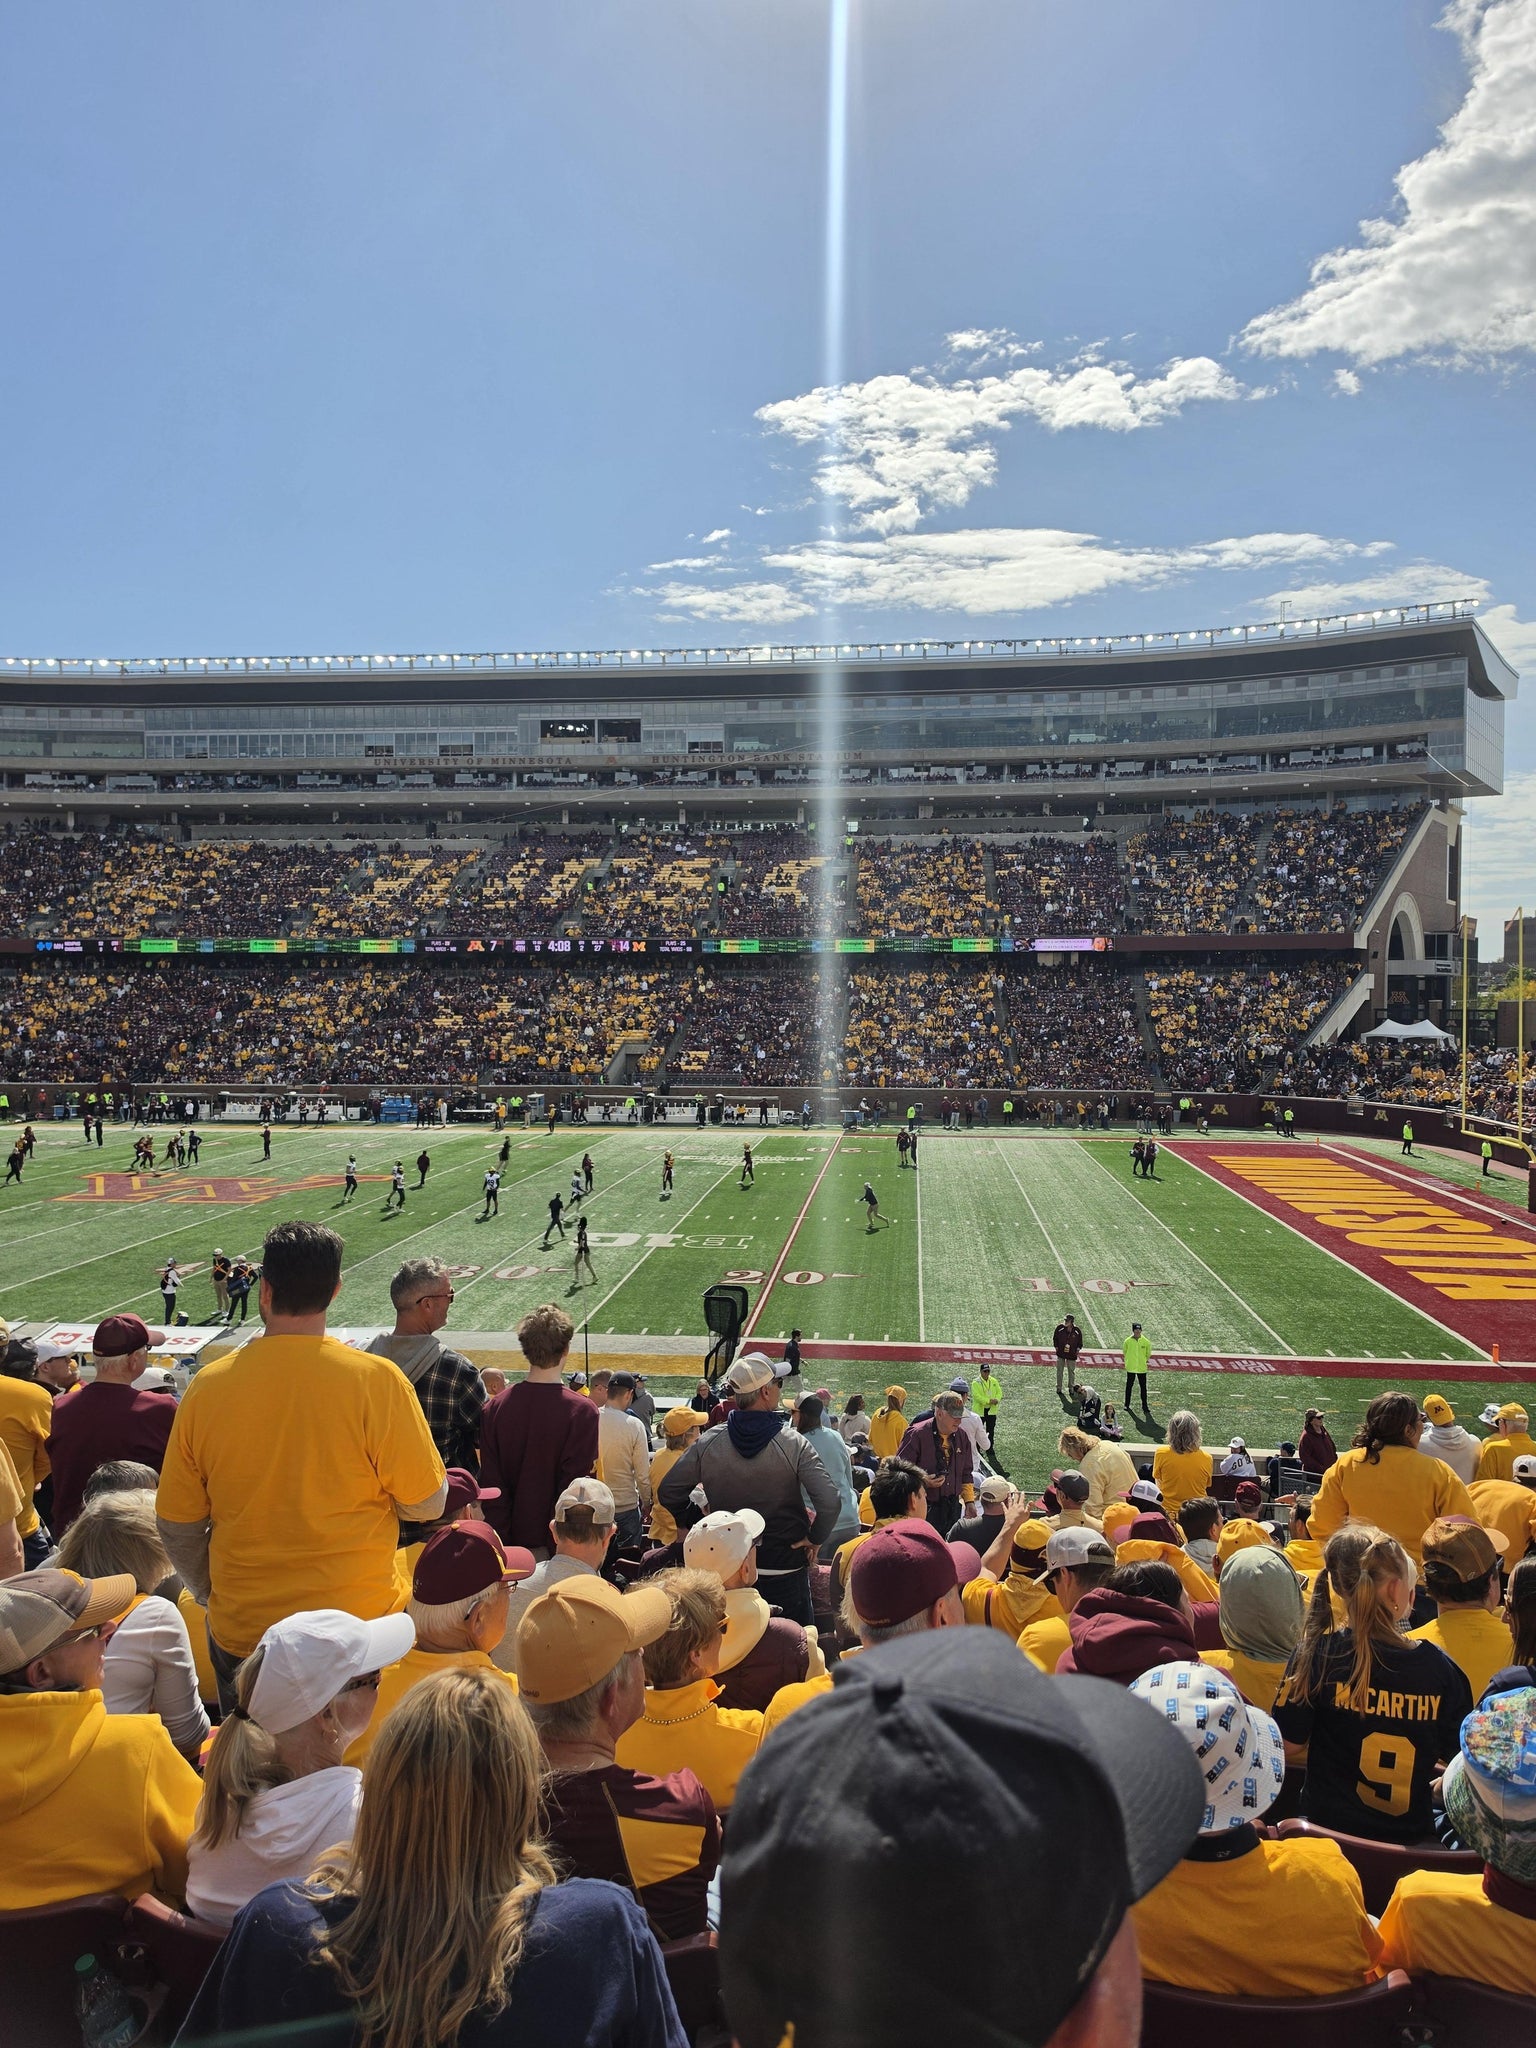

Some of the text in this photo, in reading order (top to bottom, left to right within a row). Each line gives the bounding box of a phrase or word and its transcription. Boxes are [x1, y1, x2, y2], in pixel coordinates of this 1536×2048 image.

[374, 757, 573, 766] UNIVERSITY OF MINNESOTA
[652, 752, 862, 764] HUNTINGTON BANK STAIUM
[490, 941, 497, 952] 7
[548, 940, 571, 952] 4:08
[619, 940, 630, 952] 14
[1208, 1155, 1536, 1300] MINNESOTA
[718, 1270, 827, 1286] 20
[1014, 1277, 1130, 1294] 10
[953, 1351, 1034, 1364] Bank
[1356, 1731, 1417, 1817] 9
